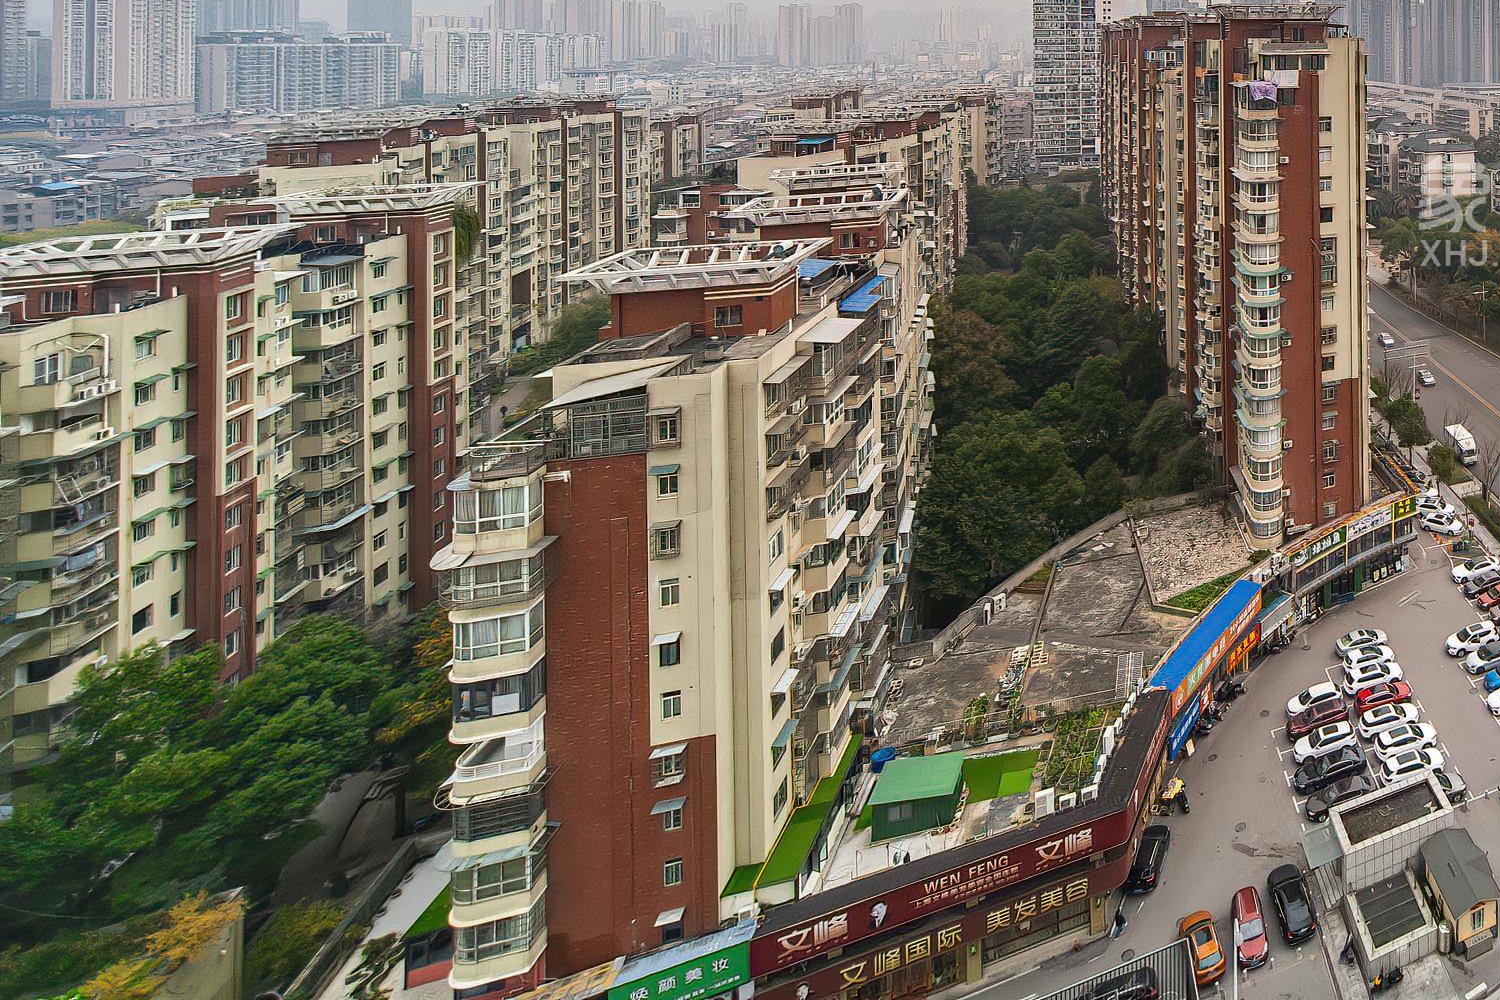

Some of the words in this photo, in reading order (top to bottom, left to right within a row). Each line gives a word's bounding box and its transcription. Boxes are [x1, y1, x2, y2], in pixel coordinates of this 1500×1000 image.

[1036, 827, 1093, 863] 文峰
[924, 872, 961, 895] WEN
[969, 855, 1010, 880] FENG
[985, 878, 1089, 933] 美发美容
[777, 913, 848, 951] 文峰
[840, 924, 963, 989] 文峰国际
